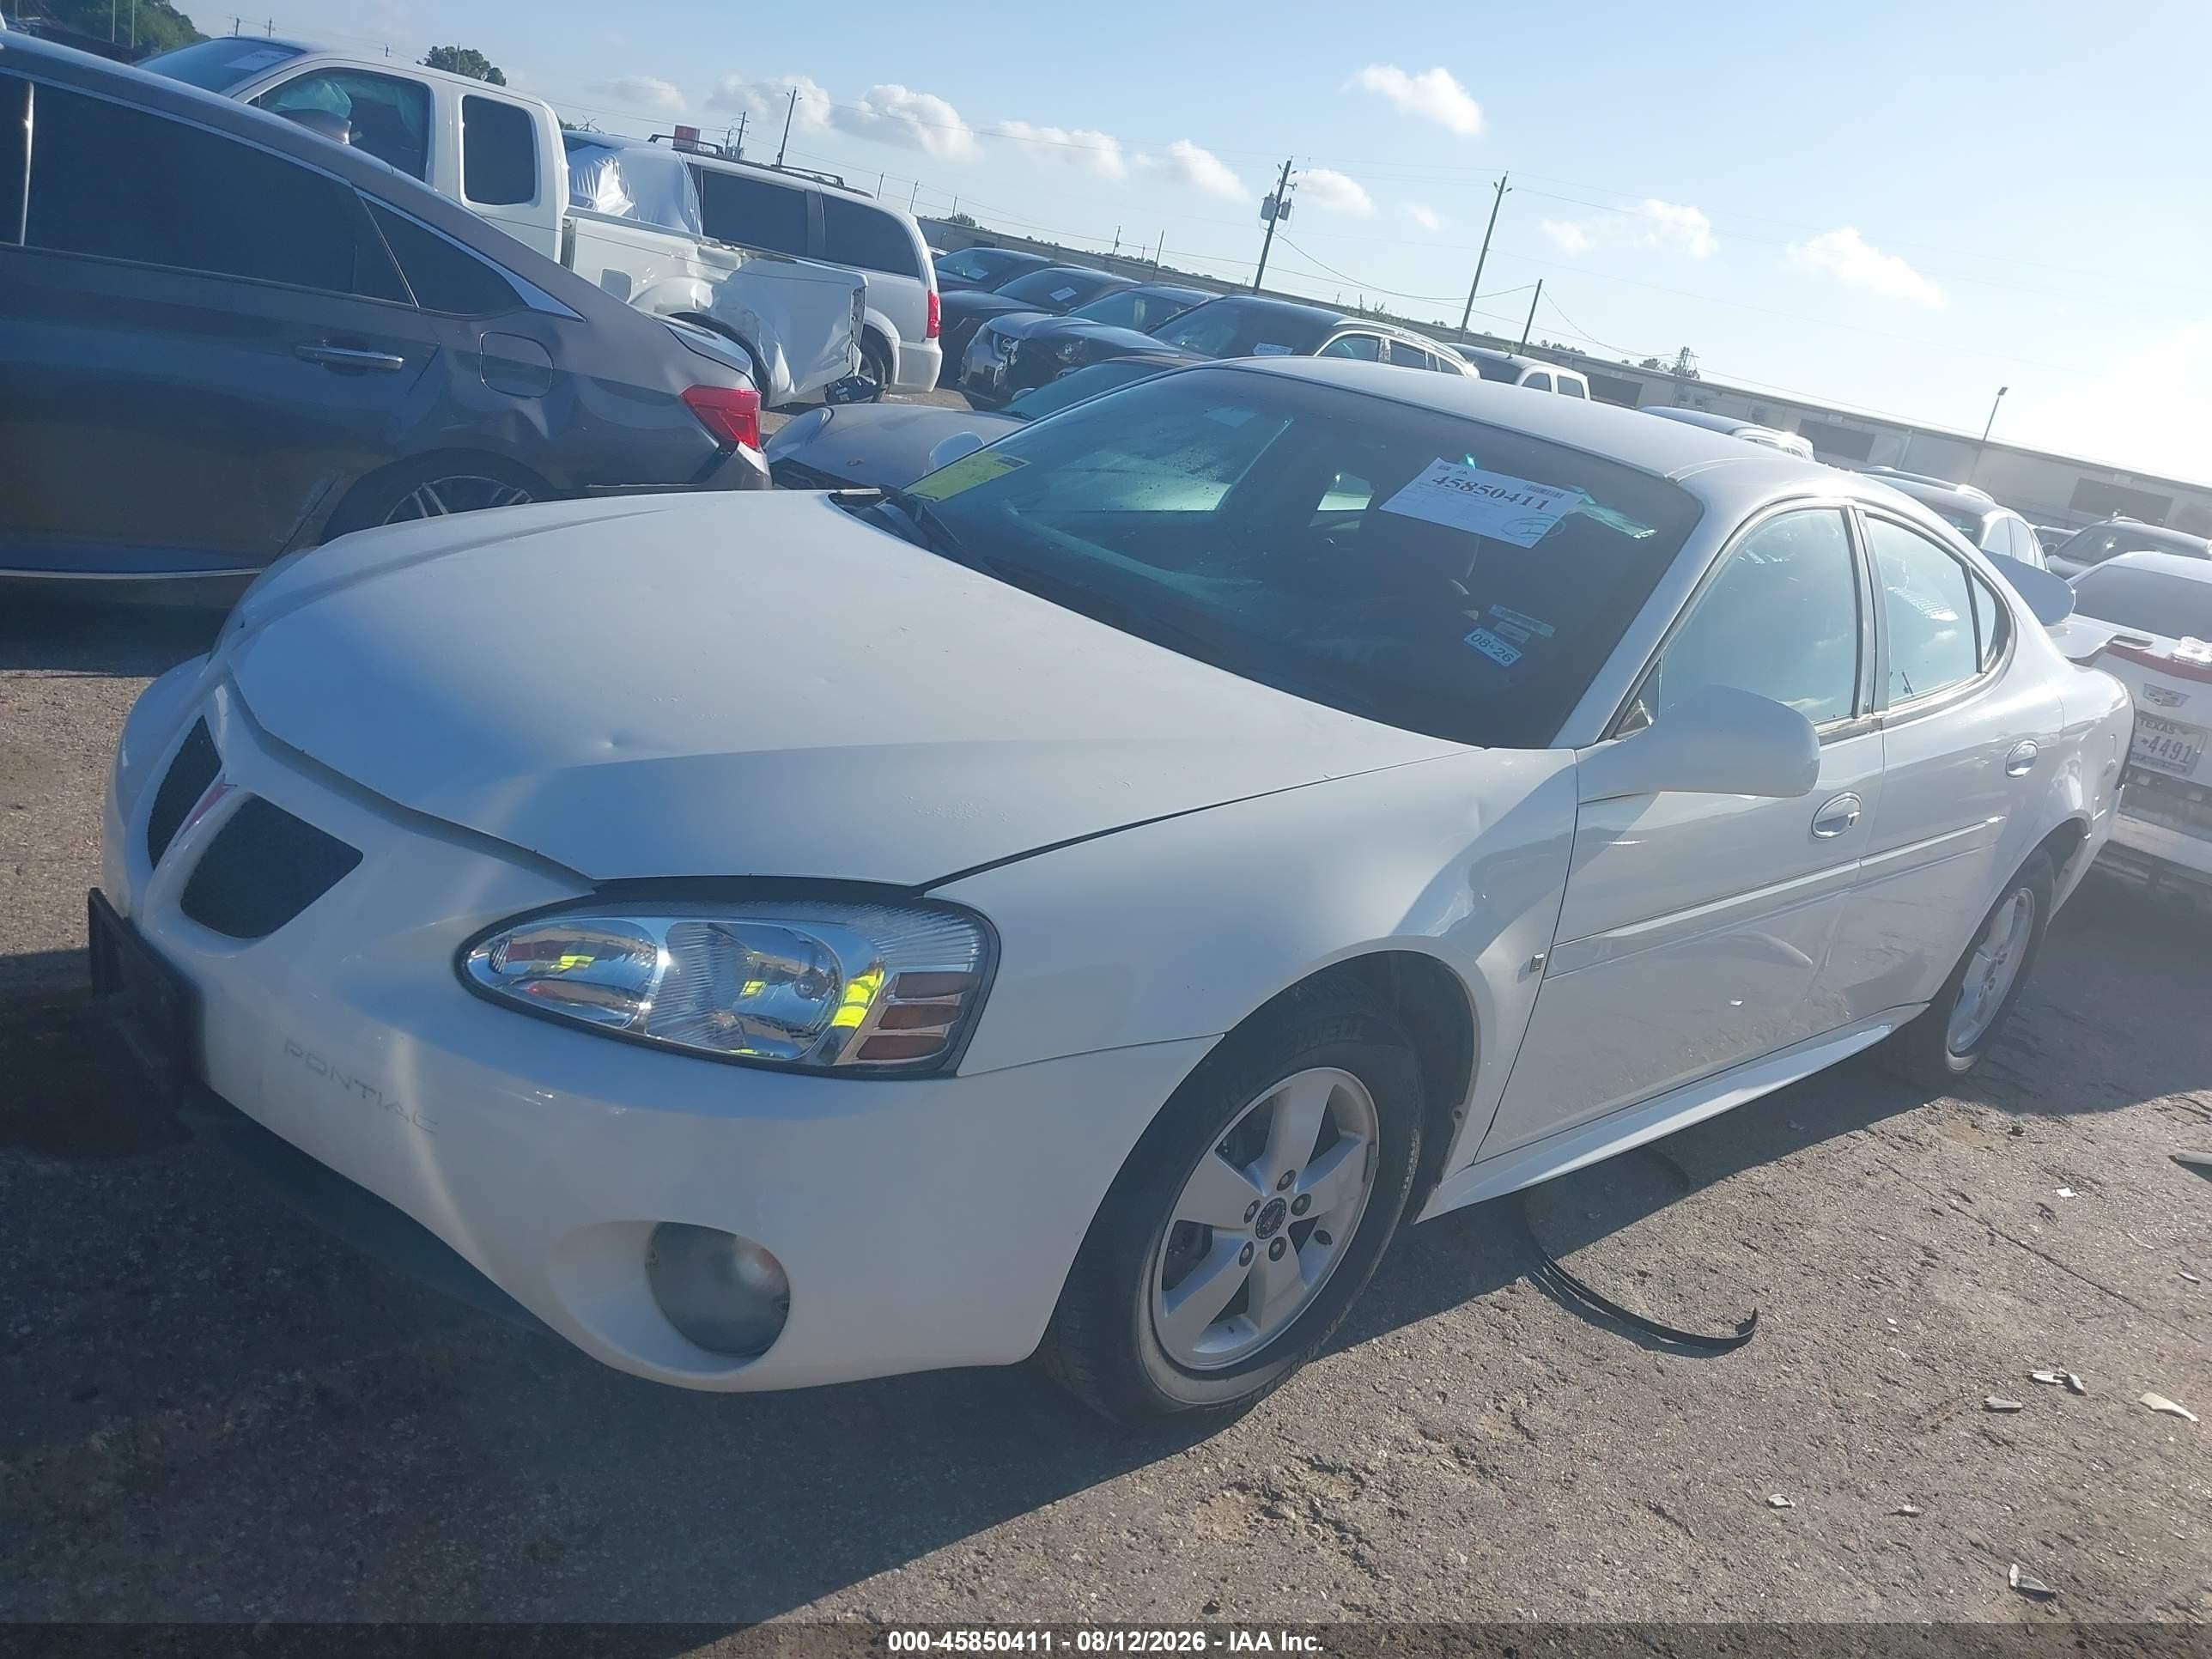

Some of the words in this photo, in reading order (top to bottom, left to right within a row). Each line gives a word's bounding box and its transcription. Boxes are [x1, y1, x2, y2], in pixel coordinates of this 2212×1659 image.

[1431, 476, 1550, 510] 45850411
[2139, 719, 2175, 735] TEXAS
[283, 1036, 439, 1135] PONTIAC
